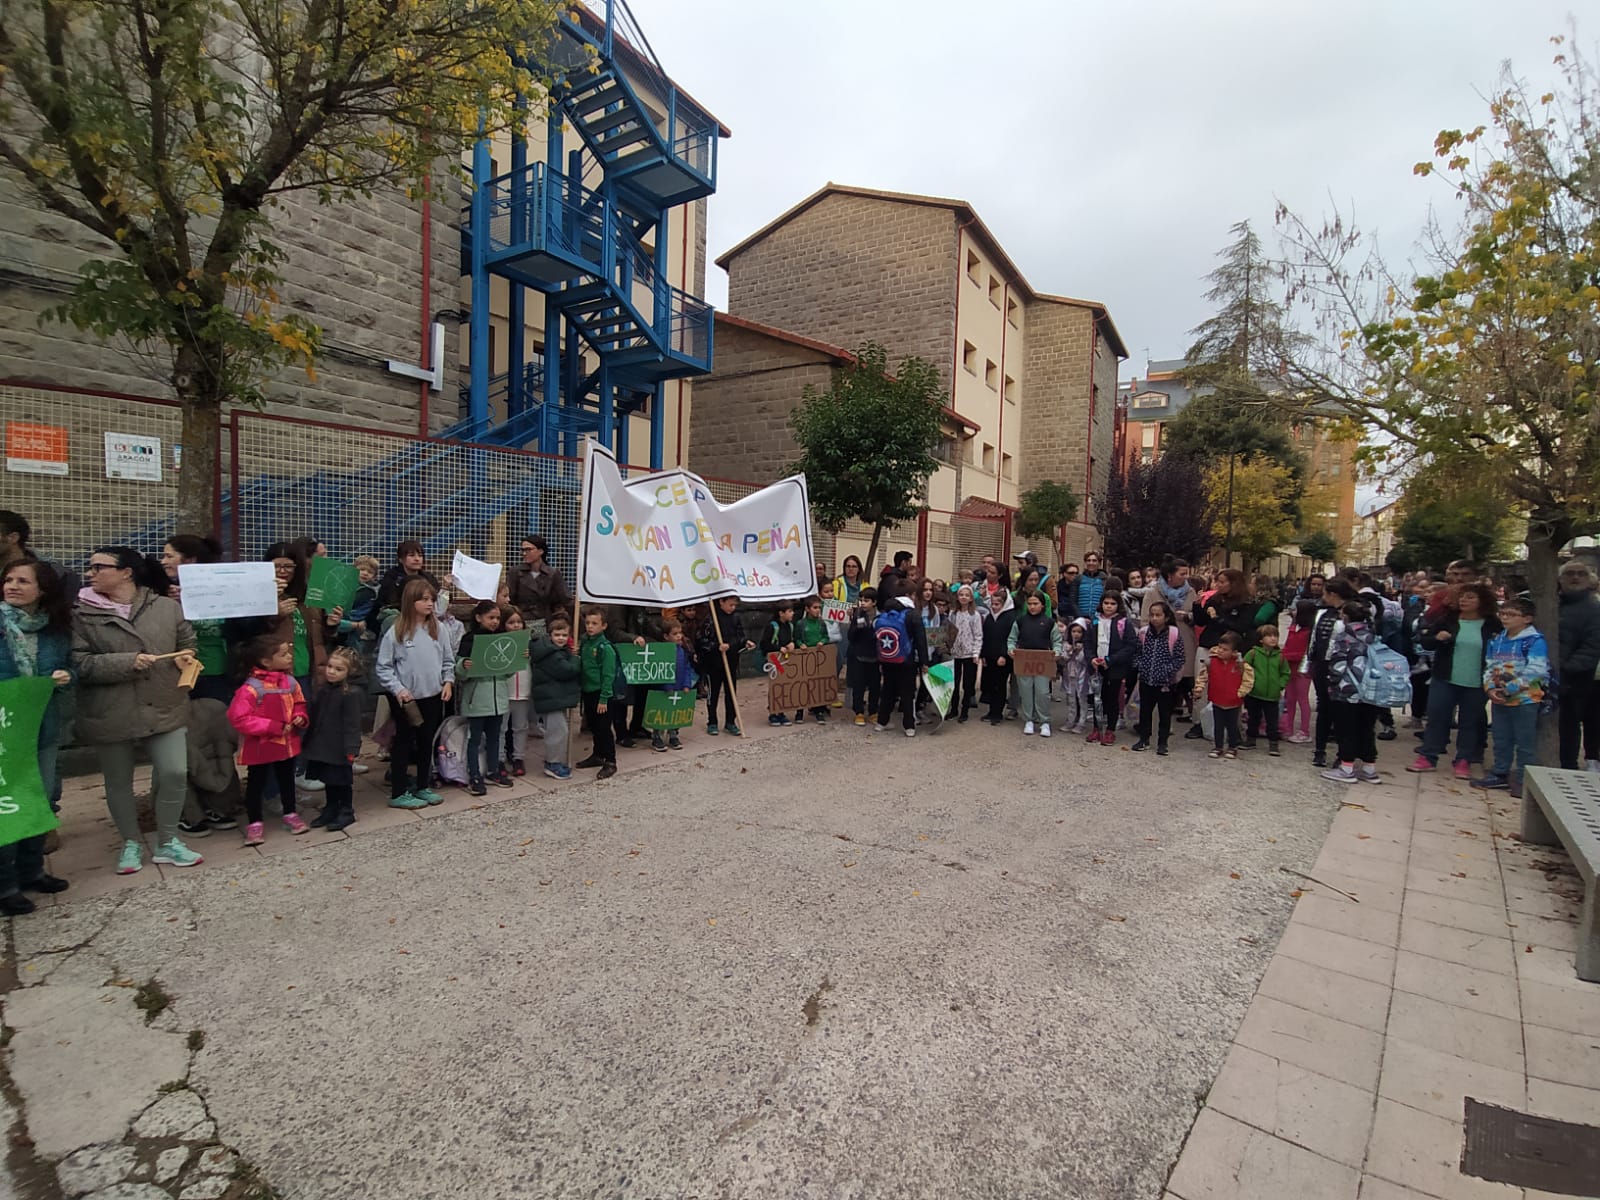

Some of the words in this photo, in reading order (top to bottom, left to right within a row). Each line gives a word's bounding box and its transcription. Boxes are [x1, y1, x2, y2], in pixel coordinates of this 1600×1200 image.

[655, 480, 706, 508] CEP
[680, 518, 715, 548] DE
[743, 522, 801, 555] PEÑA
[828, 609, 846, 622] NO
[785, 650, 827, 679] STOP
[1023, 661, 1046, 675] NO
[772, 675, 837, 711] RECORTES
